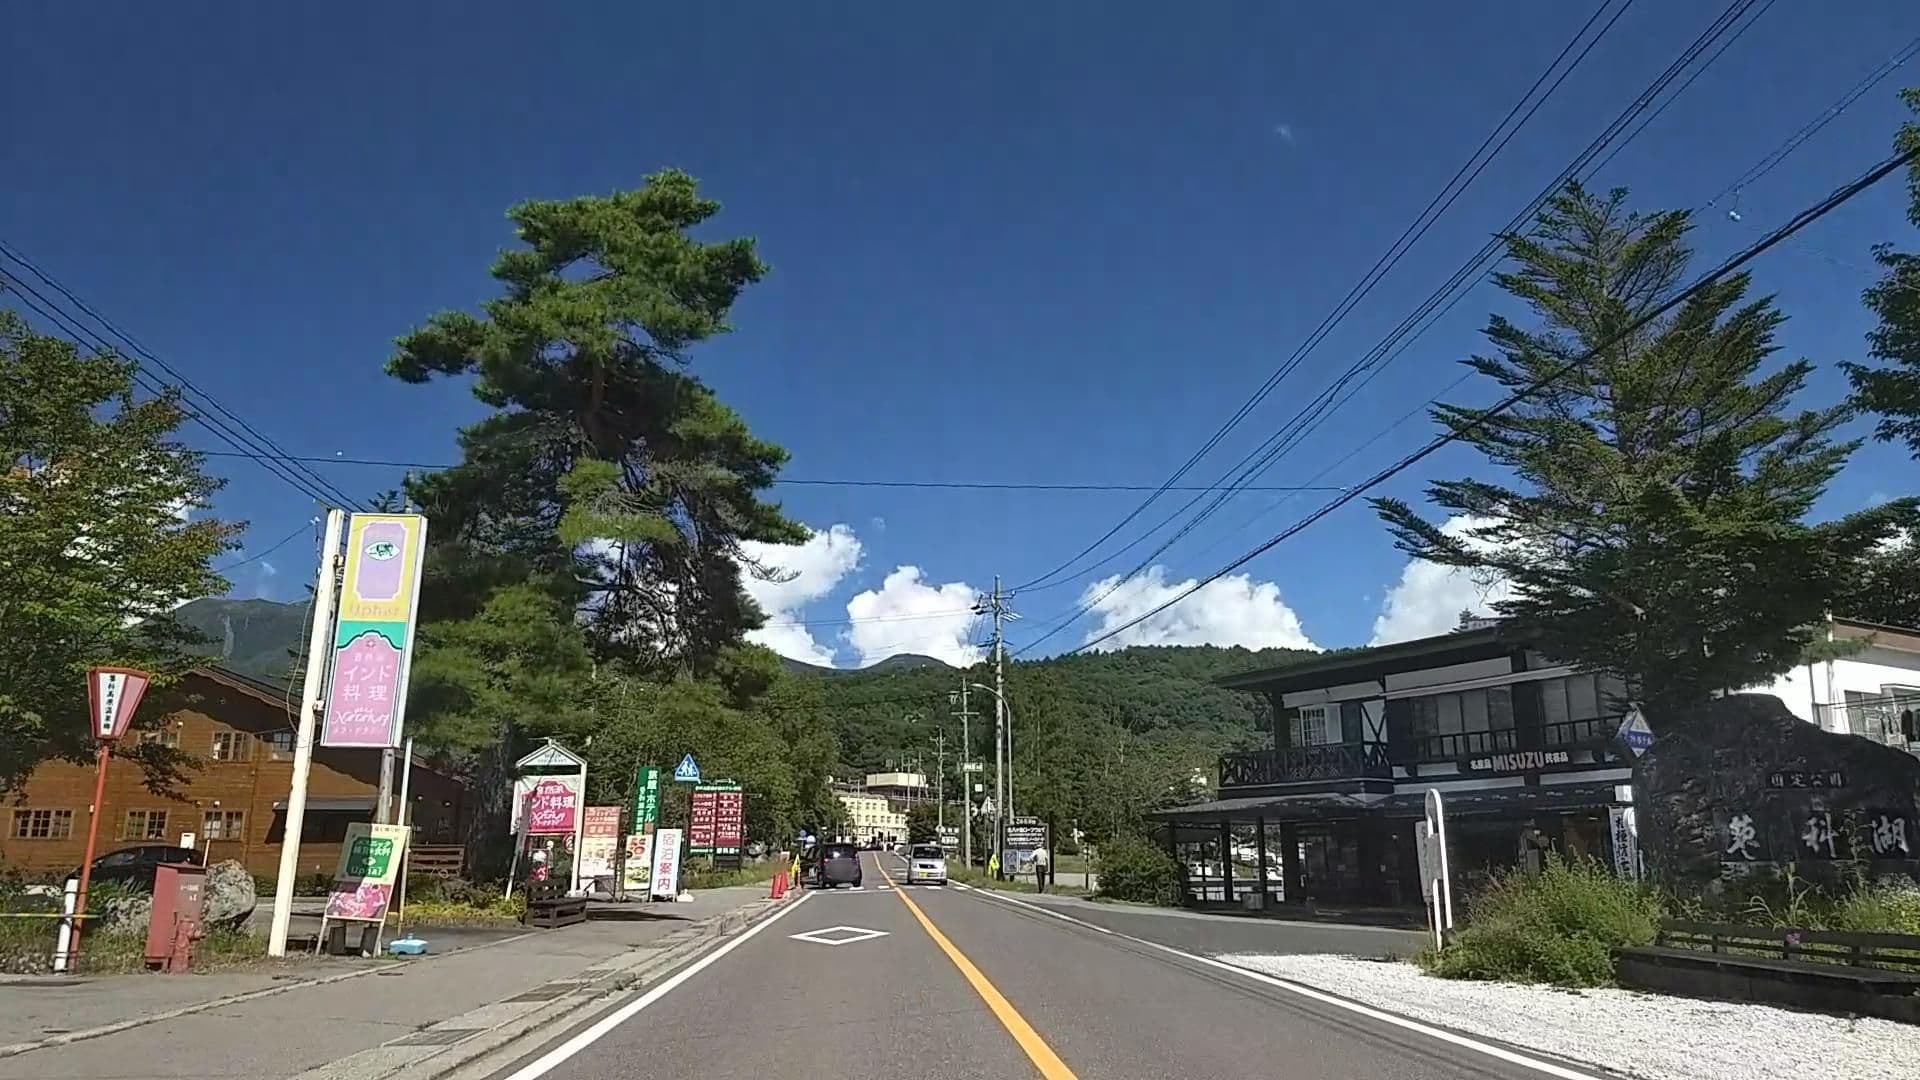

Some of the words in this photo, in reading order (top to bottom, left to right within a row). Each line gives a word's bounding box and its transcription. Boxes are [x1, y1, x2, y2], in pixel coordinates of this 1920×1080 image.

[344, 665, 392, 682] インド
[343, 684, 389, 701] 料理
[1491, 752, 1545, 772] MISUZU
[1727, 812, 1909, 860] 蓼科湖
[658, 834, 675, 890] 宿泊案内
